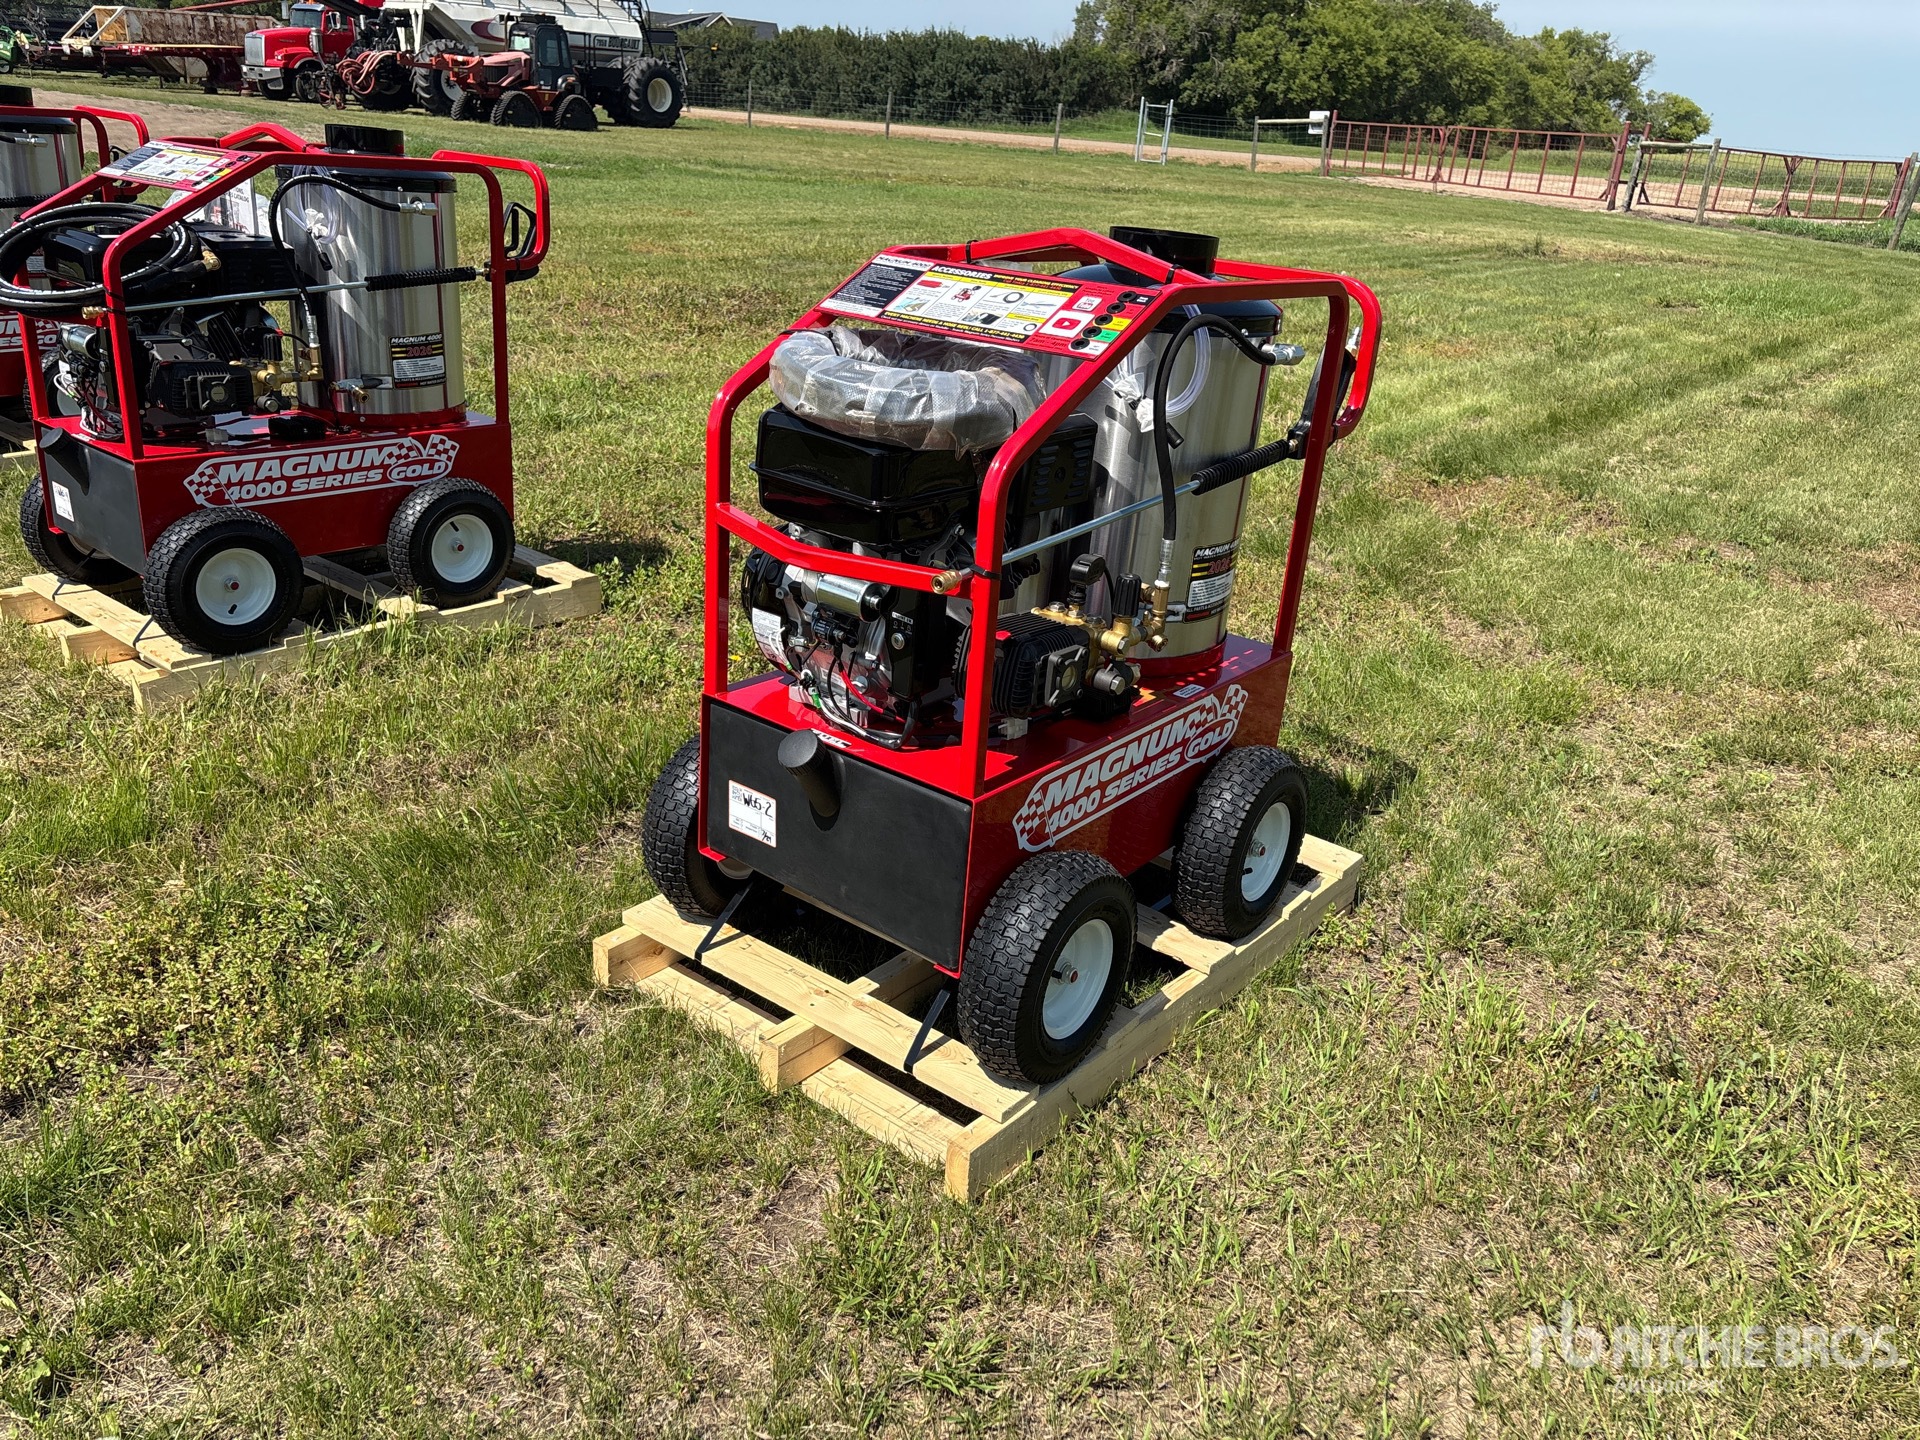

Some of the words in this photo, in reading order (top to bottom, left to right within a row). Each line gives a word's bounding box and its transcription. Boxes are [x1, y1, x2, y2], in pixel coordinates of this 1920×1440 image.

[932, 265, 993, 280] ACCESSORIES
[899, 313, 922, 321] MACHINE
[217, 446, 392, 484] MAGNUM
[391, 461, 446, 480] GOLD
[225, 480, 288, 501] 4000
[290, 468, 384, 493] SERIES
[1195, 544, 1230, 557] MAGNUM
[1186, 721, 1232, 757] GOLD
[1044, 709, 1200, 811] MAGNUM
[1044, 789, 1102, 833] 4000
[1102, 746, 1182, 803] SERIES
